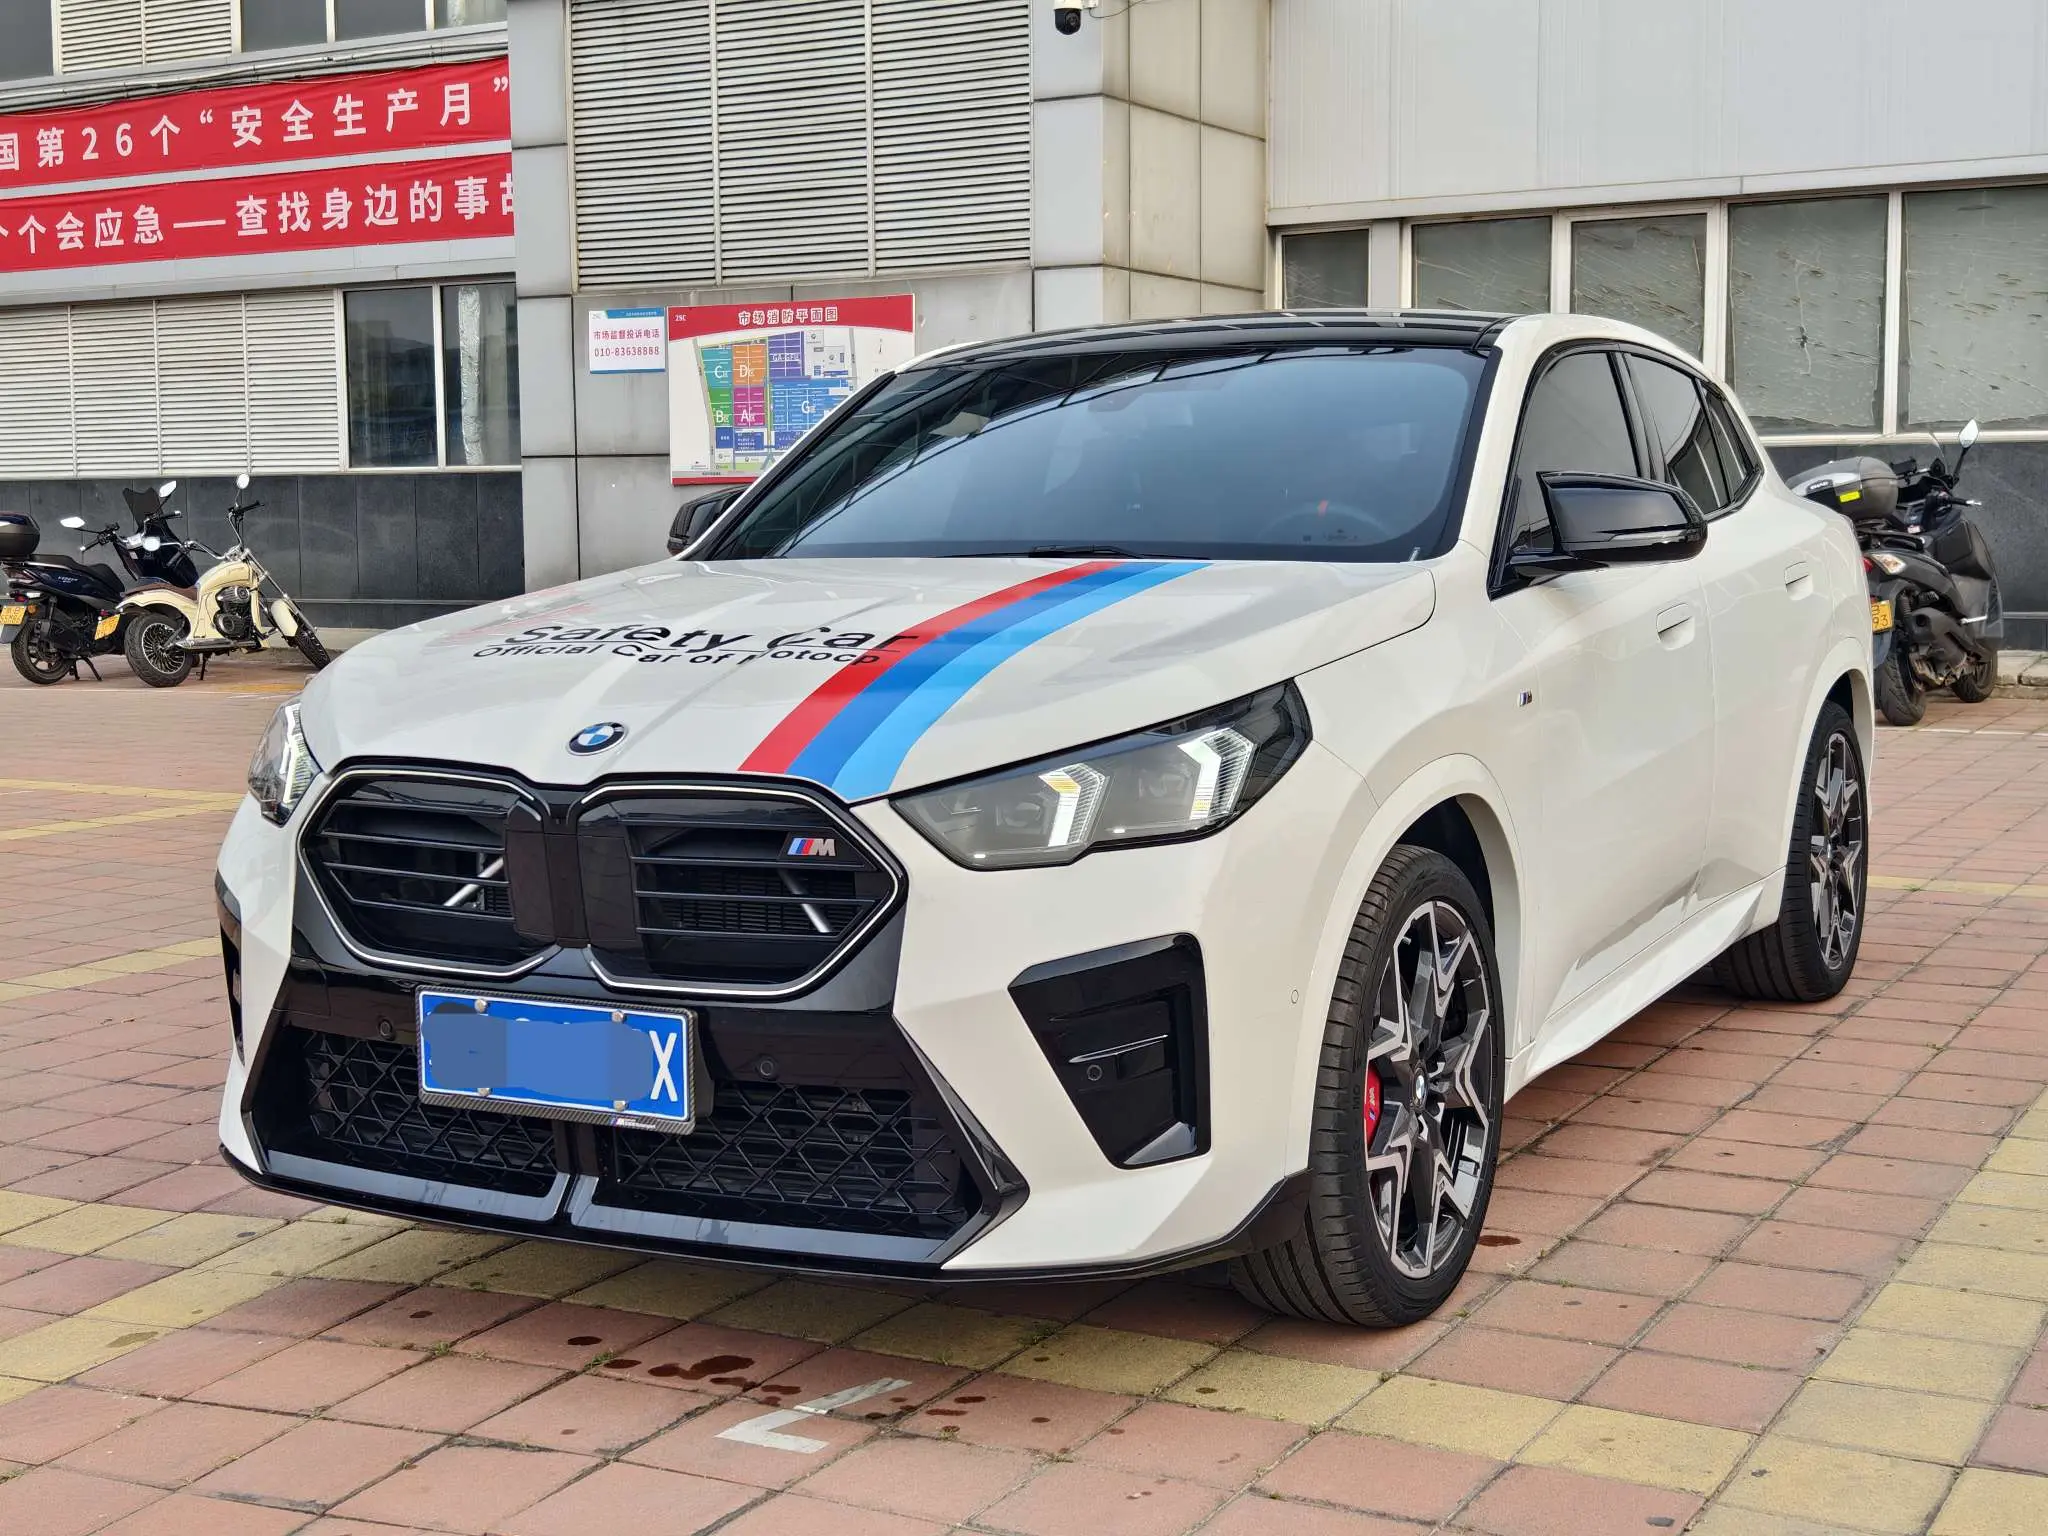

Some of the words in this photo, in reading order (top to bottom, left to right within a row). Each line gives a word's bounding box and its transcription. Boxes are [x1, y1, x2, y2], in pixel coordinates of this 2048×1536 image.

[738, 306, 838, 326] 市场消防平面图
[593, 328, 660, 341] 市场监督投诉电话
[504, 623, 754, 652] Safety
[767, 626, 918, 650] Car
[472, 643, 605, 658] Official
[612, 644, 682, 663] Car
[689, 652, 735, 664] of
